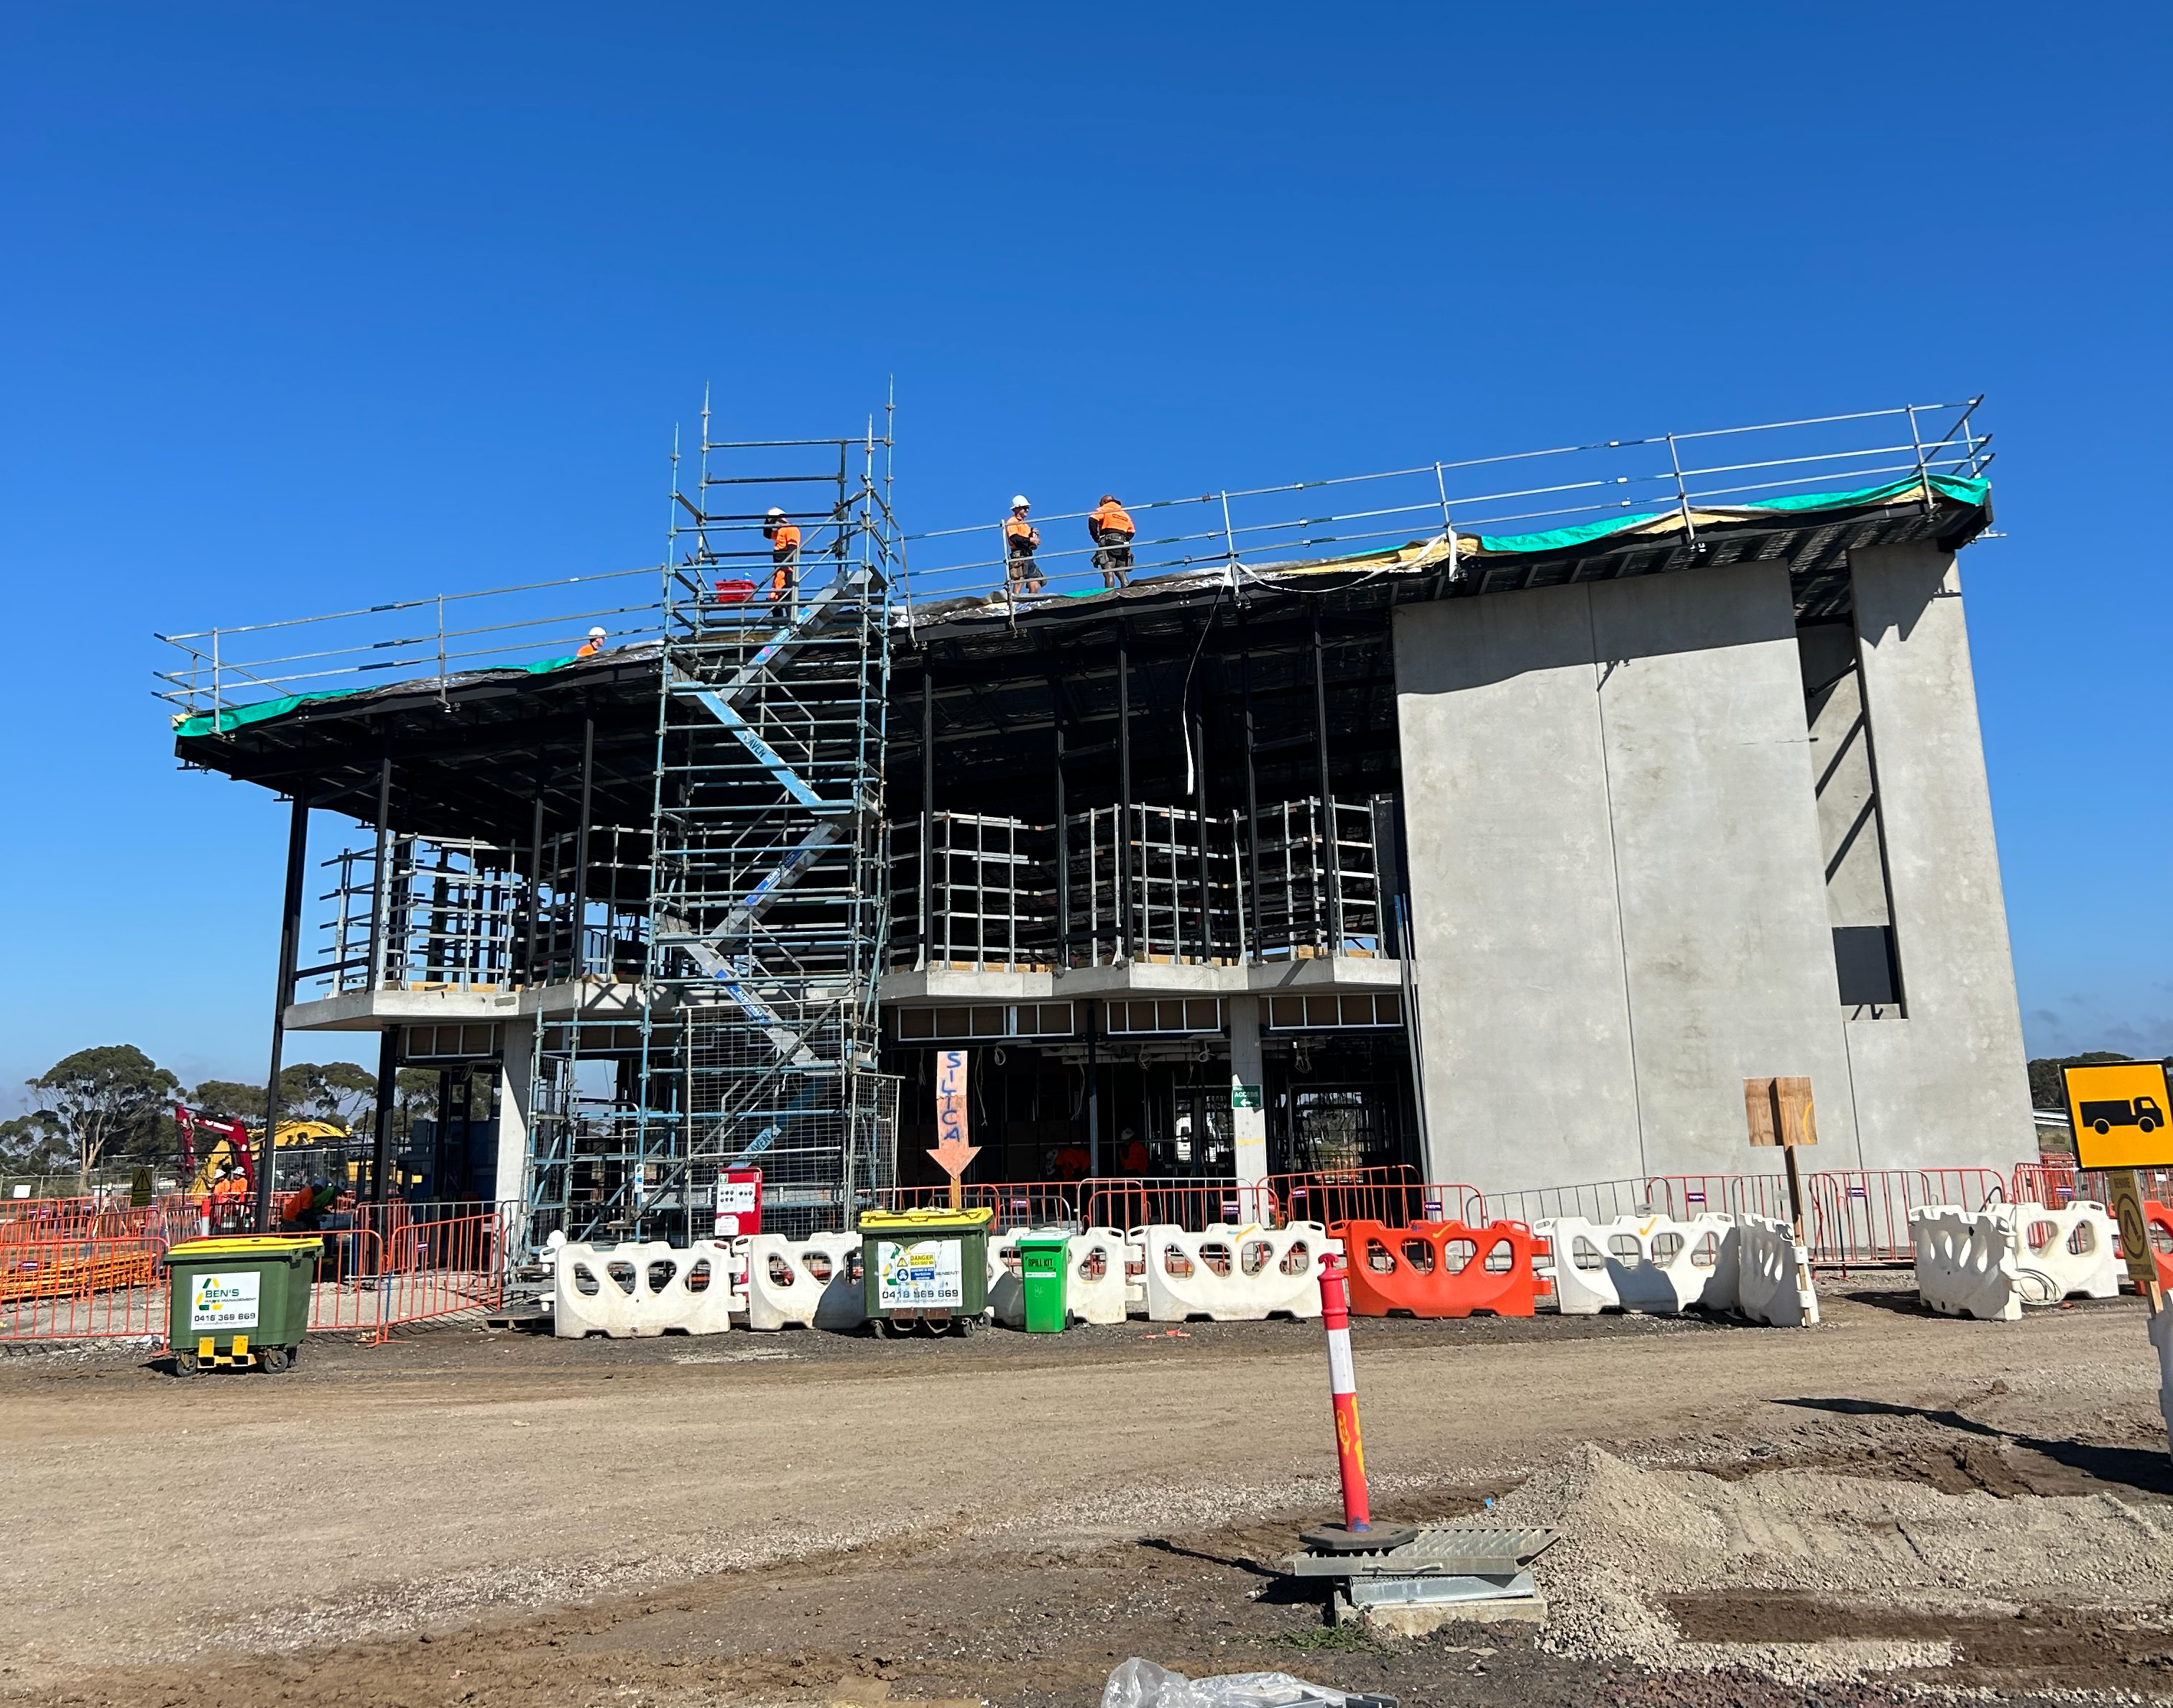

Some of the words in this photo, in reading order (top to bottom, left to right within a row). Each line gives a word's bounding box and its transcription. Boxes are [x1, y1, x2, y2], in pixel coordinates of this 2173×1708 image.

[941, 1051, 962, 1142] SILICA
[1028, 1257, 1043, 1267] SPILL
[1043, 1257, 1053, 1267] KIT
[205, 1289, 239, 1298] BEN'S
[882, 1291, 910, 1299] 0418
[938, 1289, 959, 1298] 869
